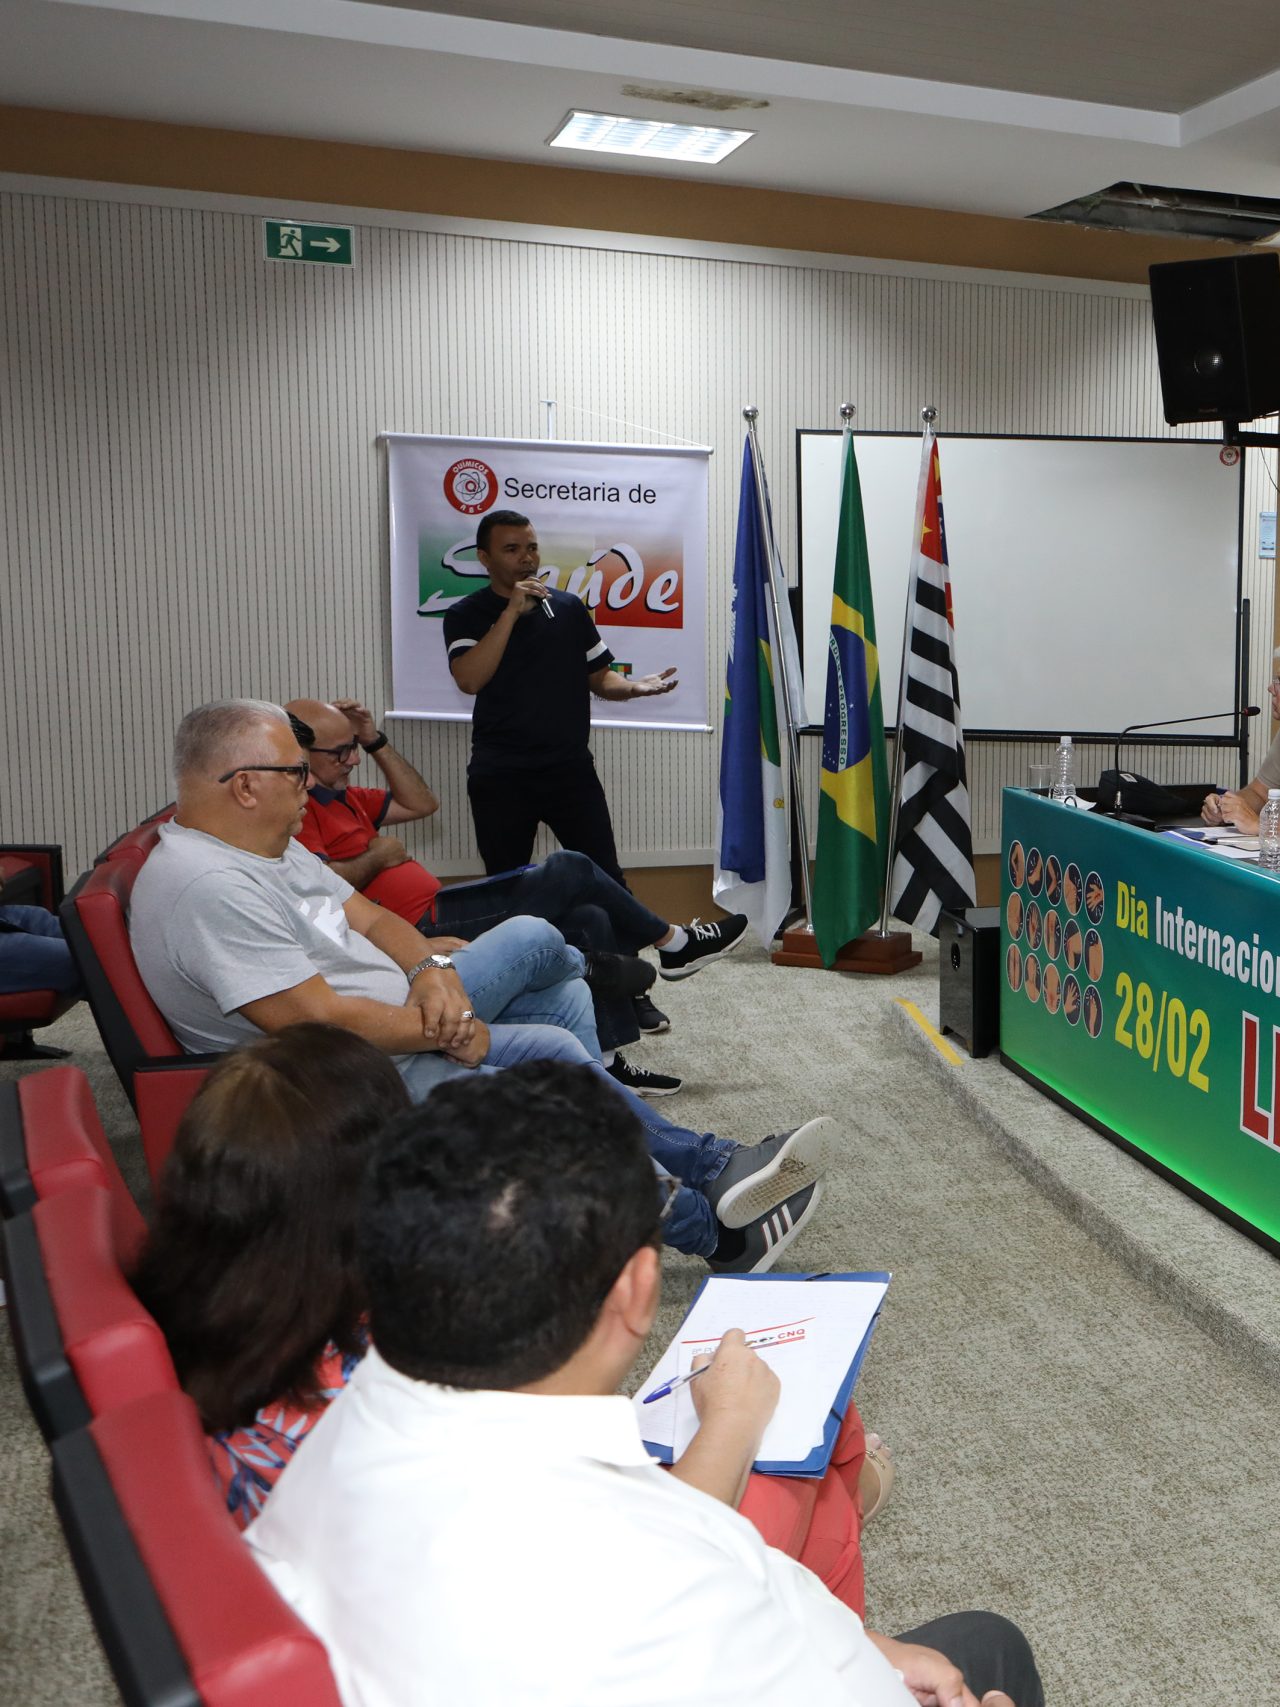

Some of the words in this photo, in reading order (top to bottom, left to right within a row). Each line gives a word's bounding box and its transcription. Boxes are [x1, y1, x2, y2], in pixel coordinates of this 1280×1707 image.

[453, 460, 489, 476] QUÍMICOS
[504, 477, 620, 504] Secretaria
[629, 484, 657, 505] de
[839, 684, 847, 765] PROGRESSO
[1115, 880, 1149, 939] Dia
[1114, 971, 1211, 1093] 28/02
[778, 1328, 806, 1339] CNQ
